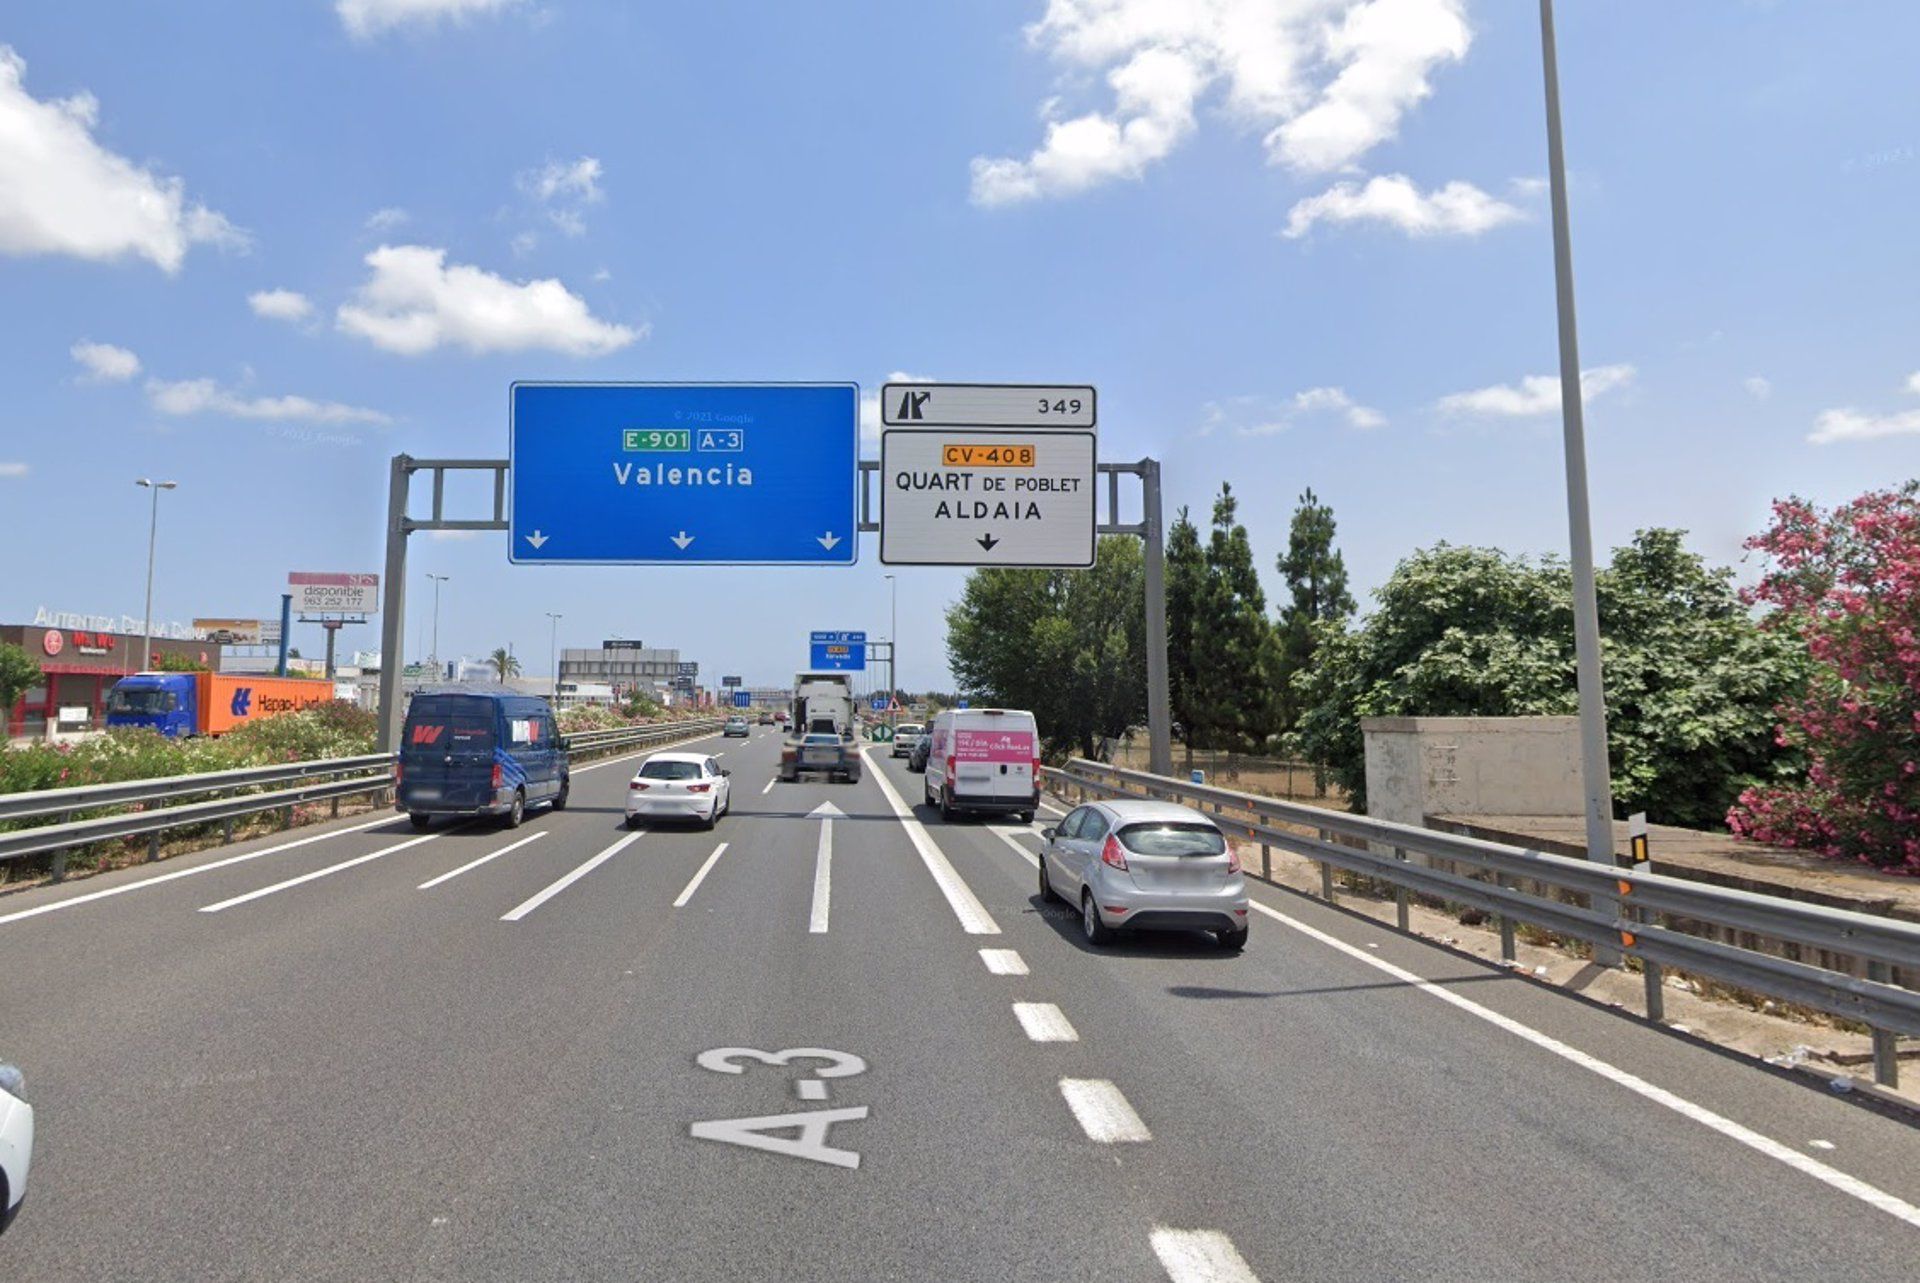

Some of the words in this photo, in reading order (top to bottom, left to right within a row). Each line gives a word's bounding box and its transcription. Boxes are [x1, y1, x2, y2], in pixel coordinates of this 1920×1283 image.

[1038, 399, 1081, 414] 349
[626, 432, 687, 447] E-901
[702, 433, 739, 447] A-3
[946, 448, 1031, 463] CV-408
[613, 463, 752, 485] Valencia
[896, 472, 973, 491] QUART
[983, 477, 1005, 491] DE
[1015, 478, 1081, 492] POBLET
[935, 501, 1041, 519] ALDAIA
[304, 586, 364, 599] disponible
[258, 694, 320, 714] Hapag-Lld
[690, 1047, 868, 1169] A-3
